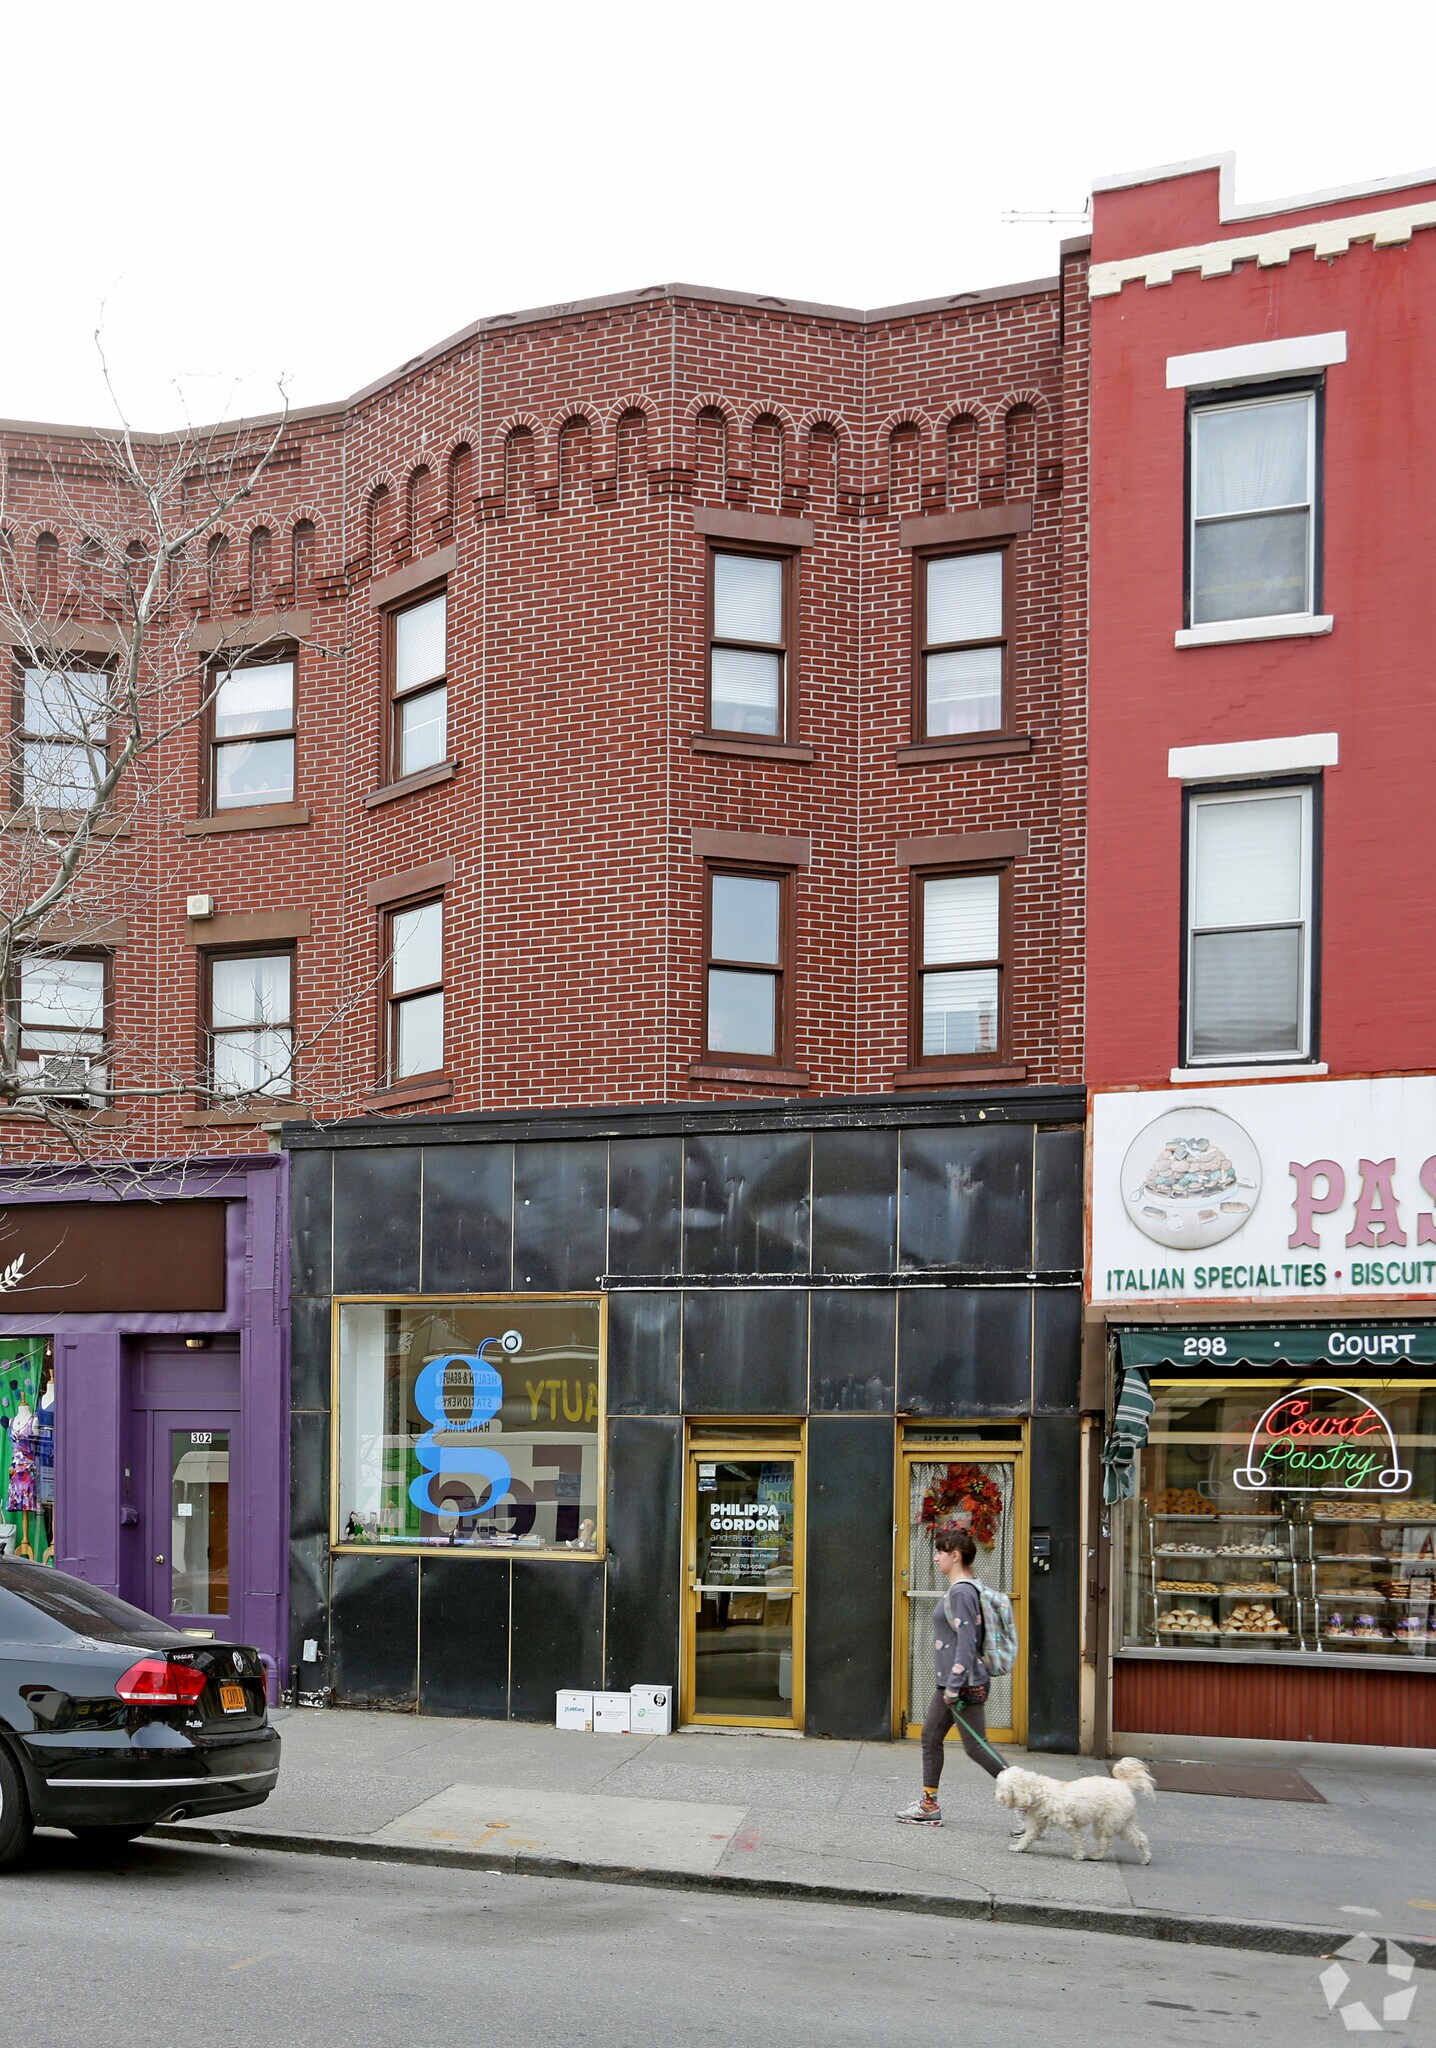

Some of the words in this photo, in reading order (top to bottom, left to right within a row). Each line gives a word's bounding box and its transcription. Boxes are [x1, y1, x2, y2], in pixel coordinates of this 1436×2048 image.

[1107, 1267, 1185, 1291] ITALIAN
[1194, 1262, 1327, 1289] SPECIALTIES
[1351, 1260, 1436, 1286] BISCUIT
[1184, 1337, 1227, 1356] 298
[1328, 1331, 1416, 1356] COURT
[1266, 1400, 1382, 1437] Court
[192, 1433, 211, 1443] 302
[1259, 1437, 1385, 1488] Pastry
[710, 1503, 779, 1516] PHILIPPA
[710, 1518, 780, 1531] GORDON
[710, 1533, 728, 1542] and
[732, 1534, 779, 1543] associates
